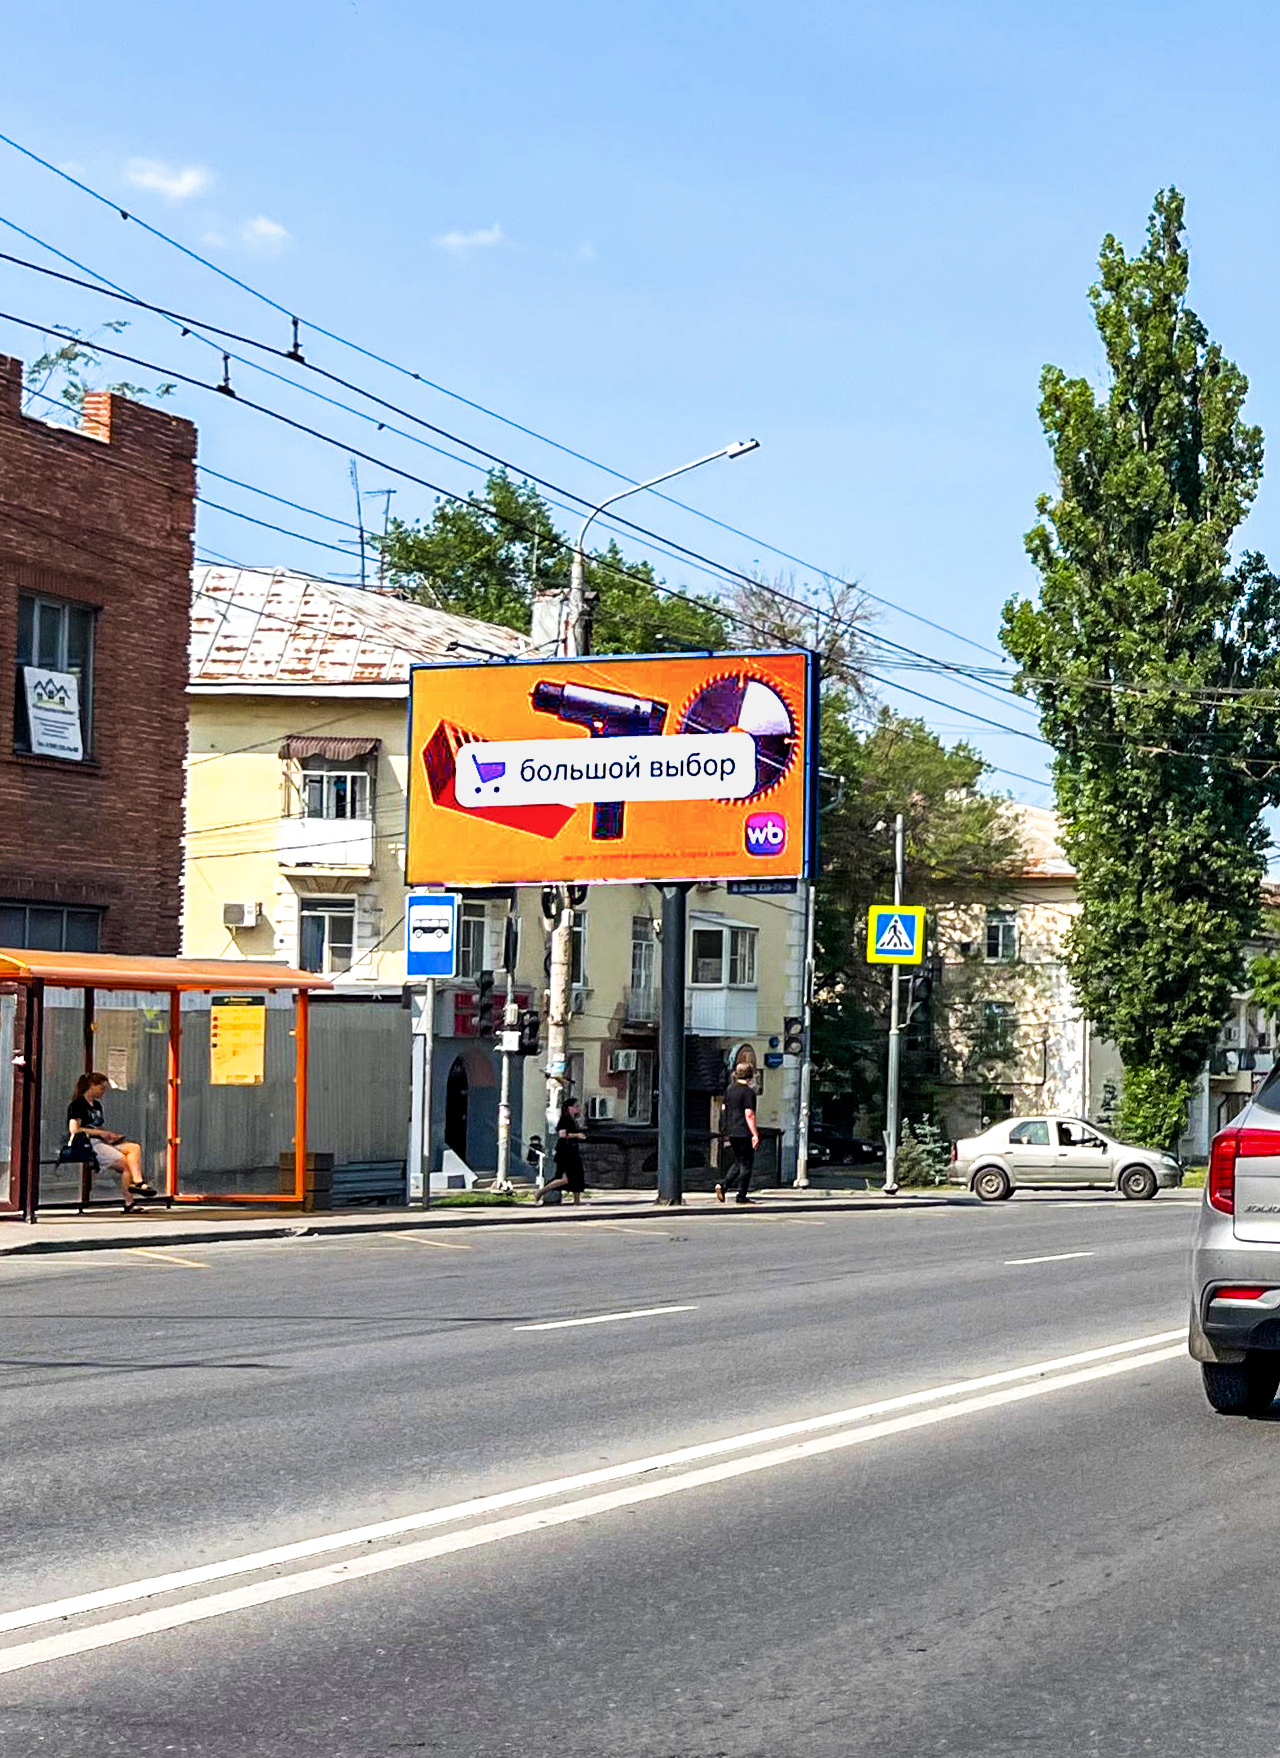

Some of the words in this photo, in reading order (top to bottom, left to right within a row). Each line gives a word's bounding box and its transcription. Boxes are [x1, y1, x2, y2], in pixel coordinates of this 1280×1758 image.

[519, 755, 641, 782] большой
[650, 753, 736, 780] выбор
[747, 820, 783, 845] wb
